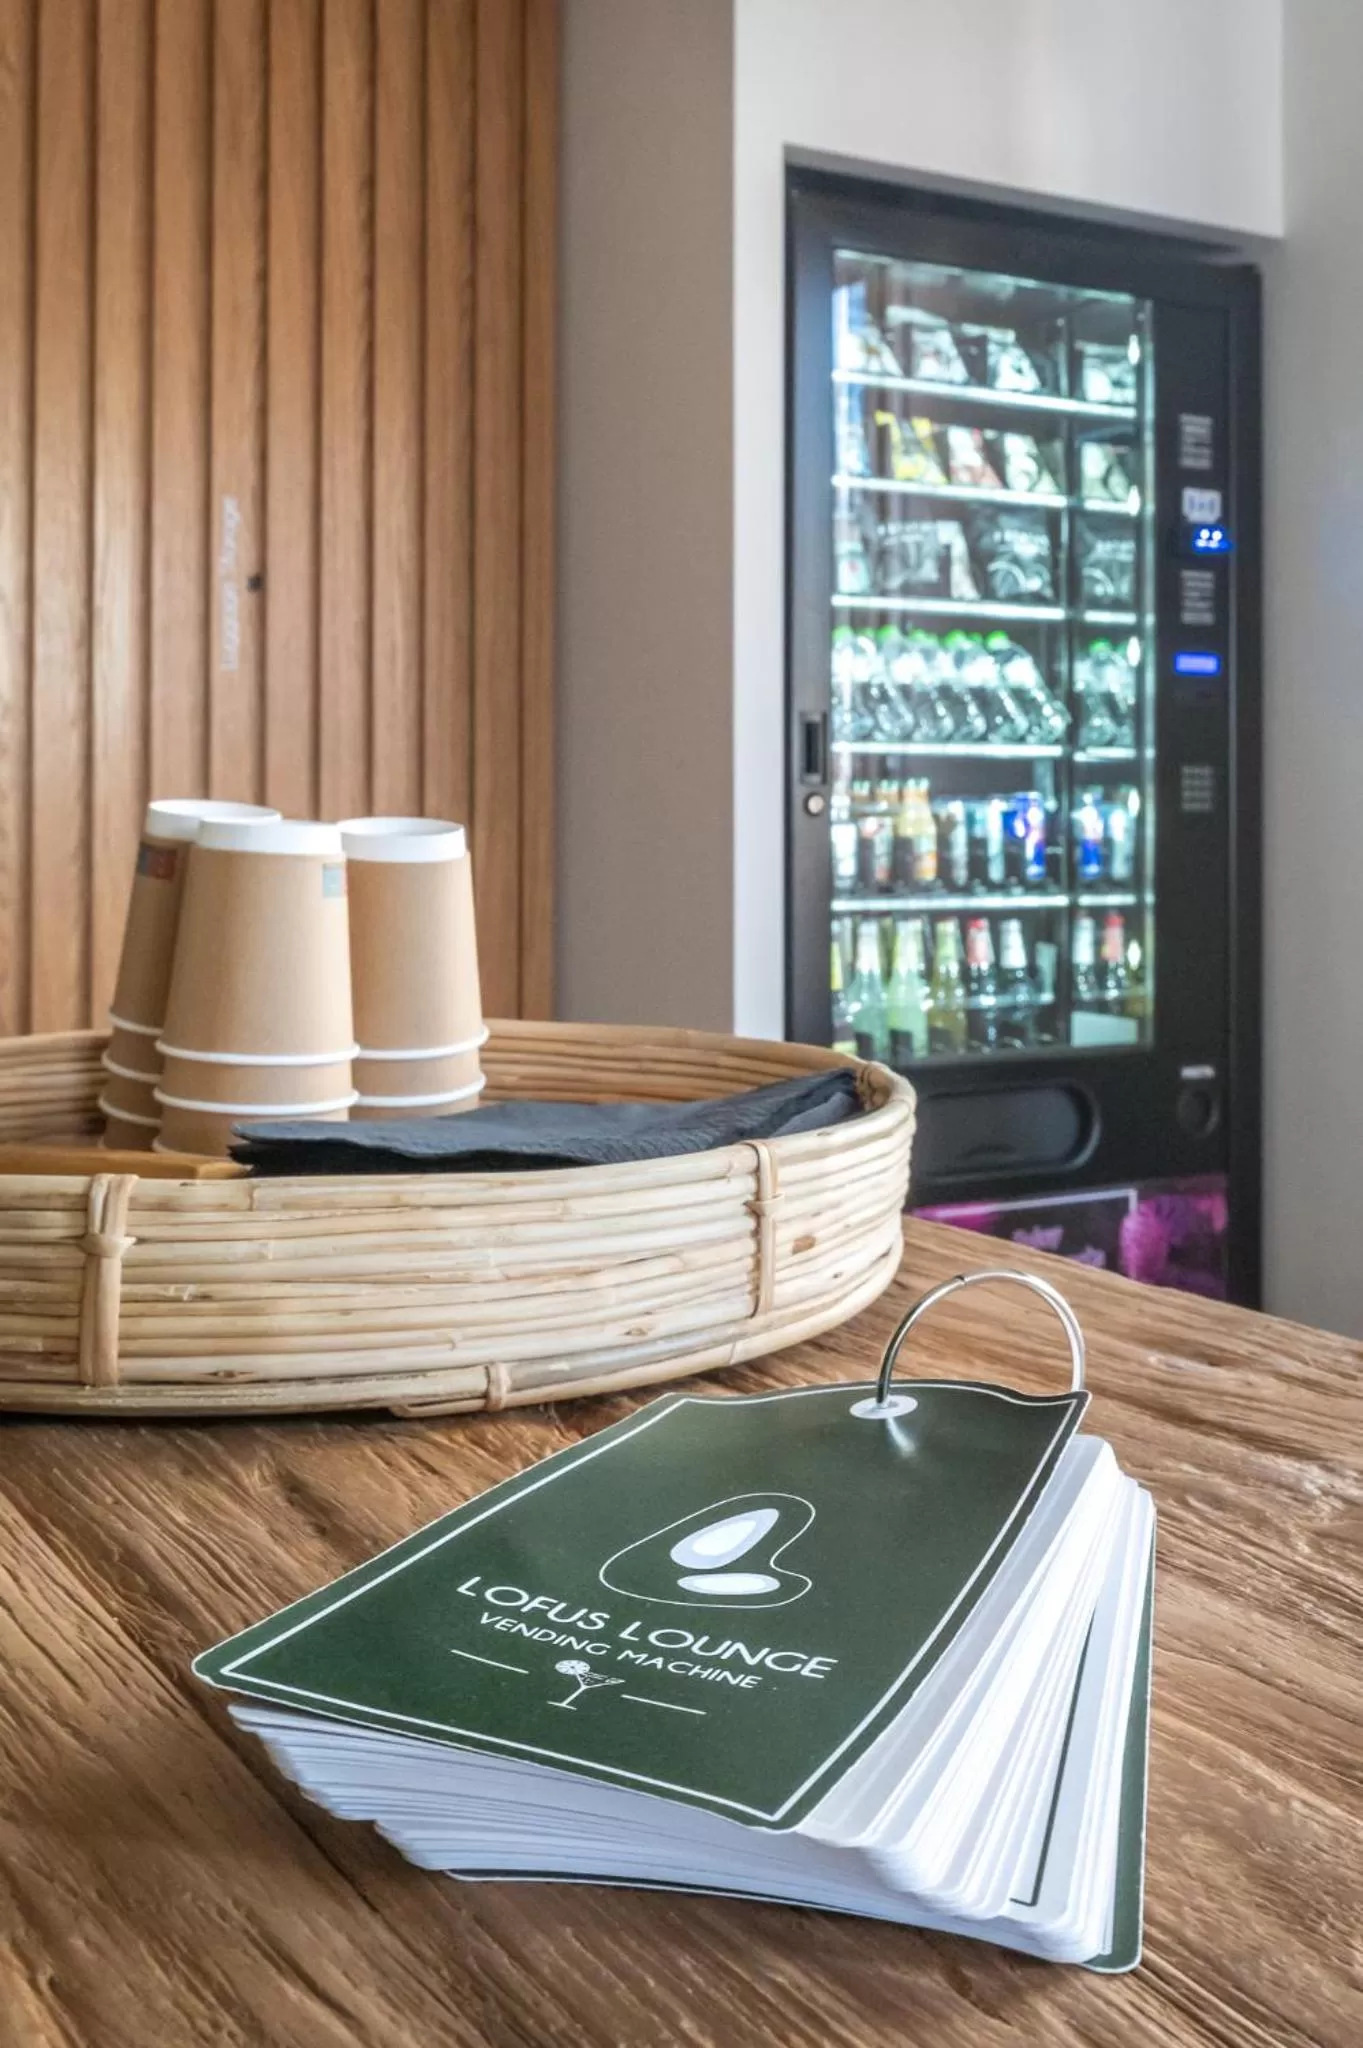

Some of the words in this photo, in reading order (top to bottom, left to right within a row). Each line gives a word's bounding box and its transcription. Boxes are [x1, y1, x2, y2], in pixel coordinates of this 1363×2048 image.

[457, 1577, 611, 1630] LOFUS
[619, 1621, 838, 1679] LOUNGE
[480, 1612, 611, 1656] VENDING
[616, 1649, 763, 1689] MACHINE
